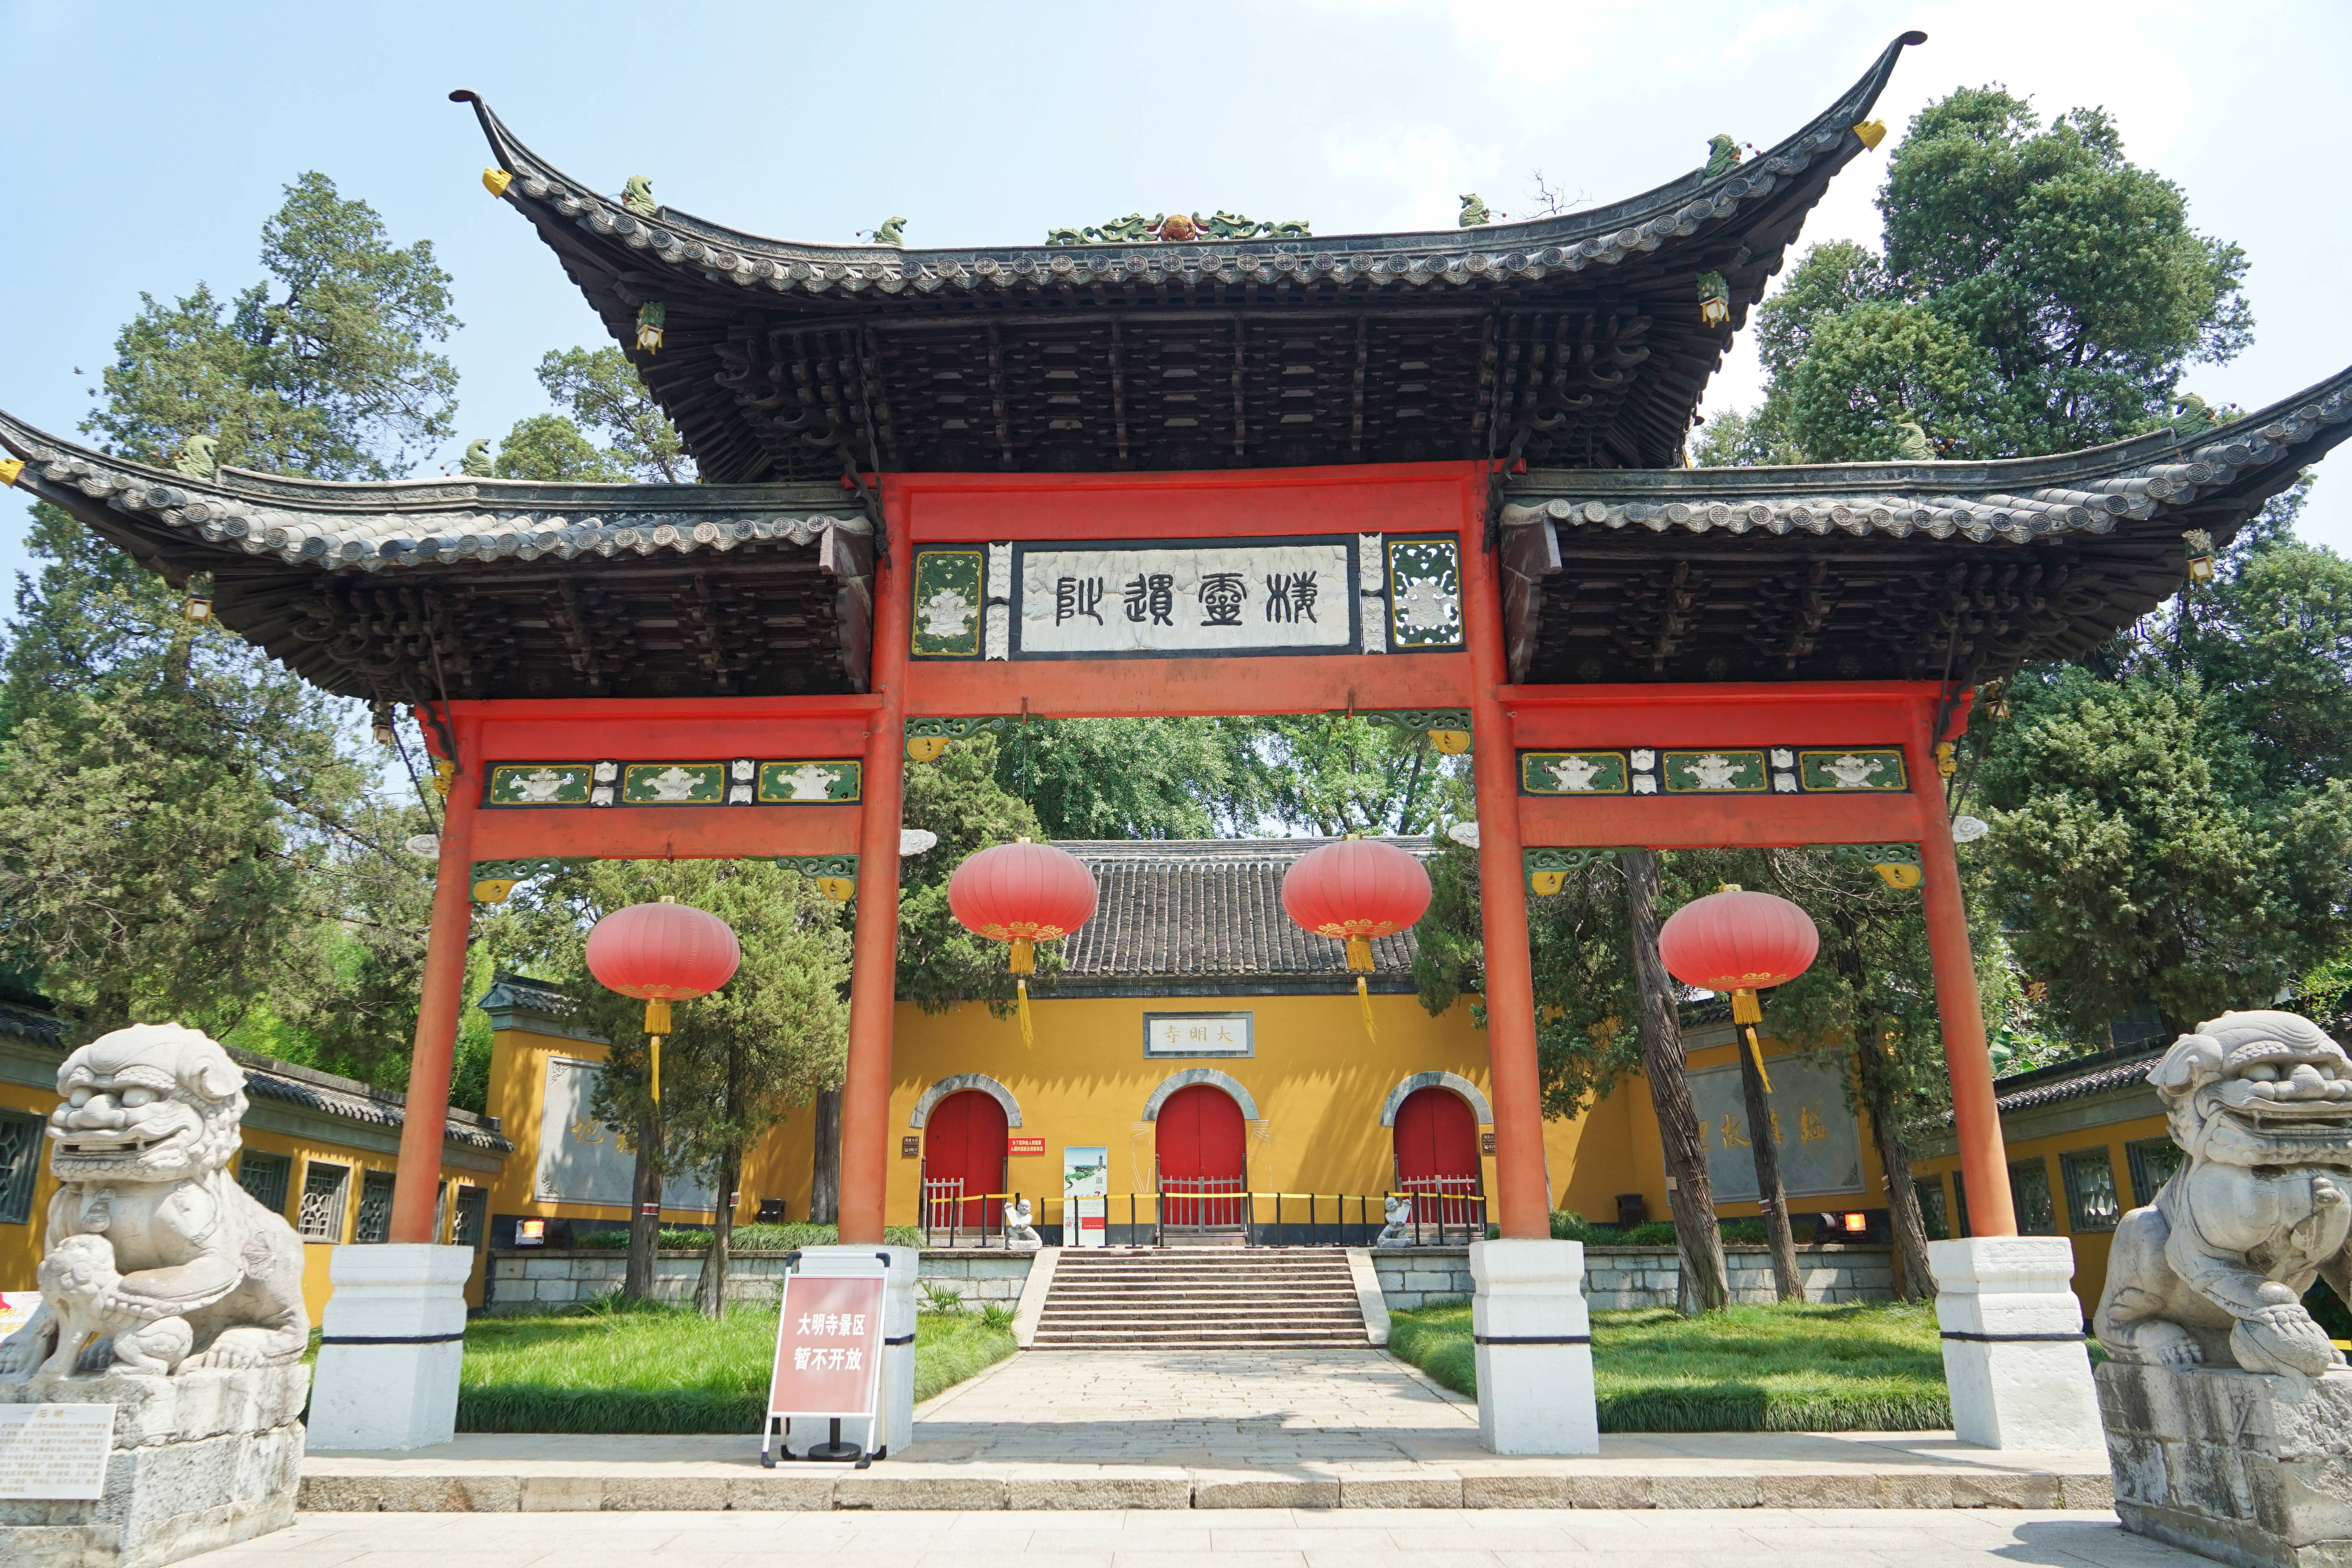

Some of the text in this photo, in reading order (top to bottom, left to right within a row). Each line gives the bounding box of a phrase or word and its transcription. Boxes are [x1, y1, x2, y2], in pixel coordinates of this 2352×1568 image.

[1163, 1025, 1233, 1044] 大明寺
[797, 1312, 866, 1336] 大明寺景区
[794, 1346, 862, 1371] 暂不开放
